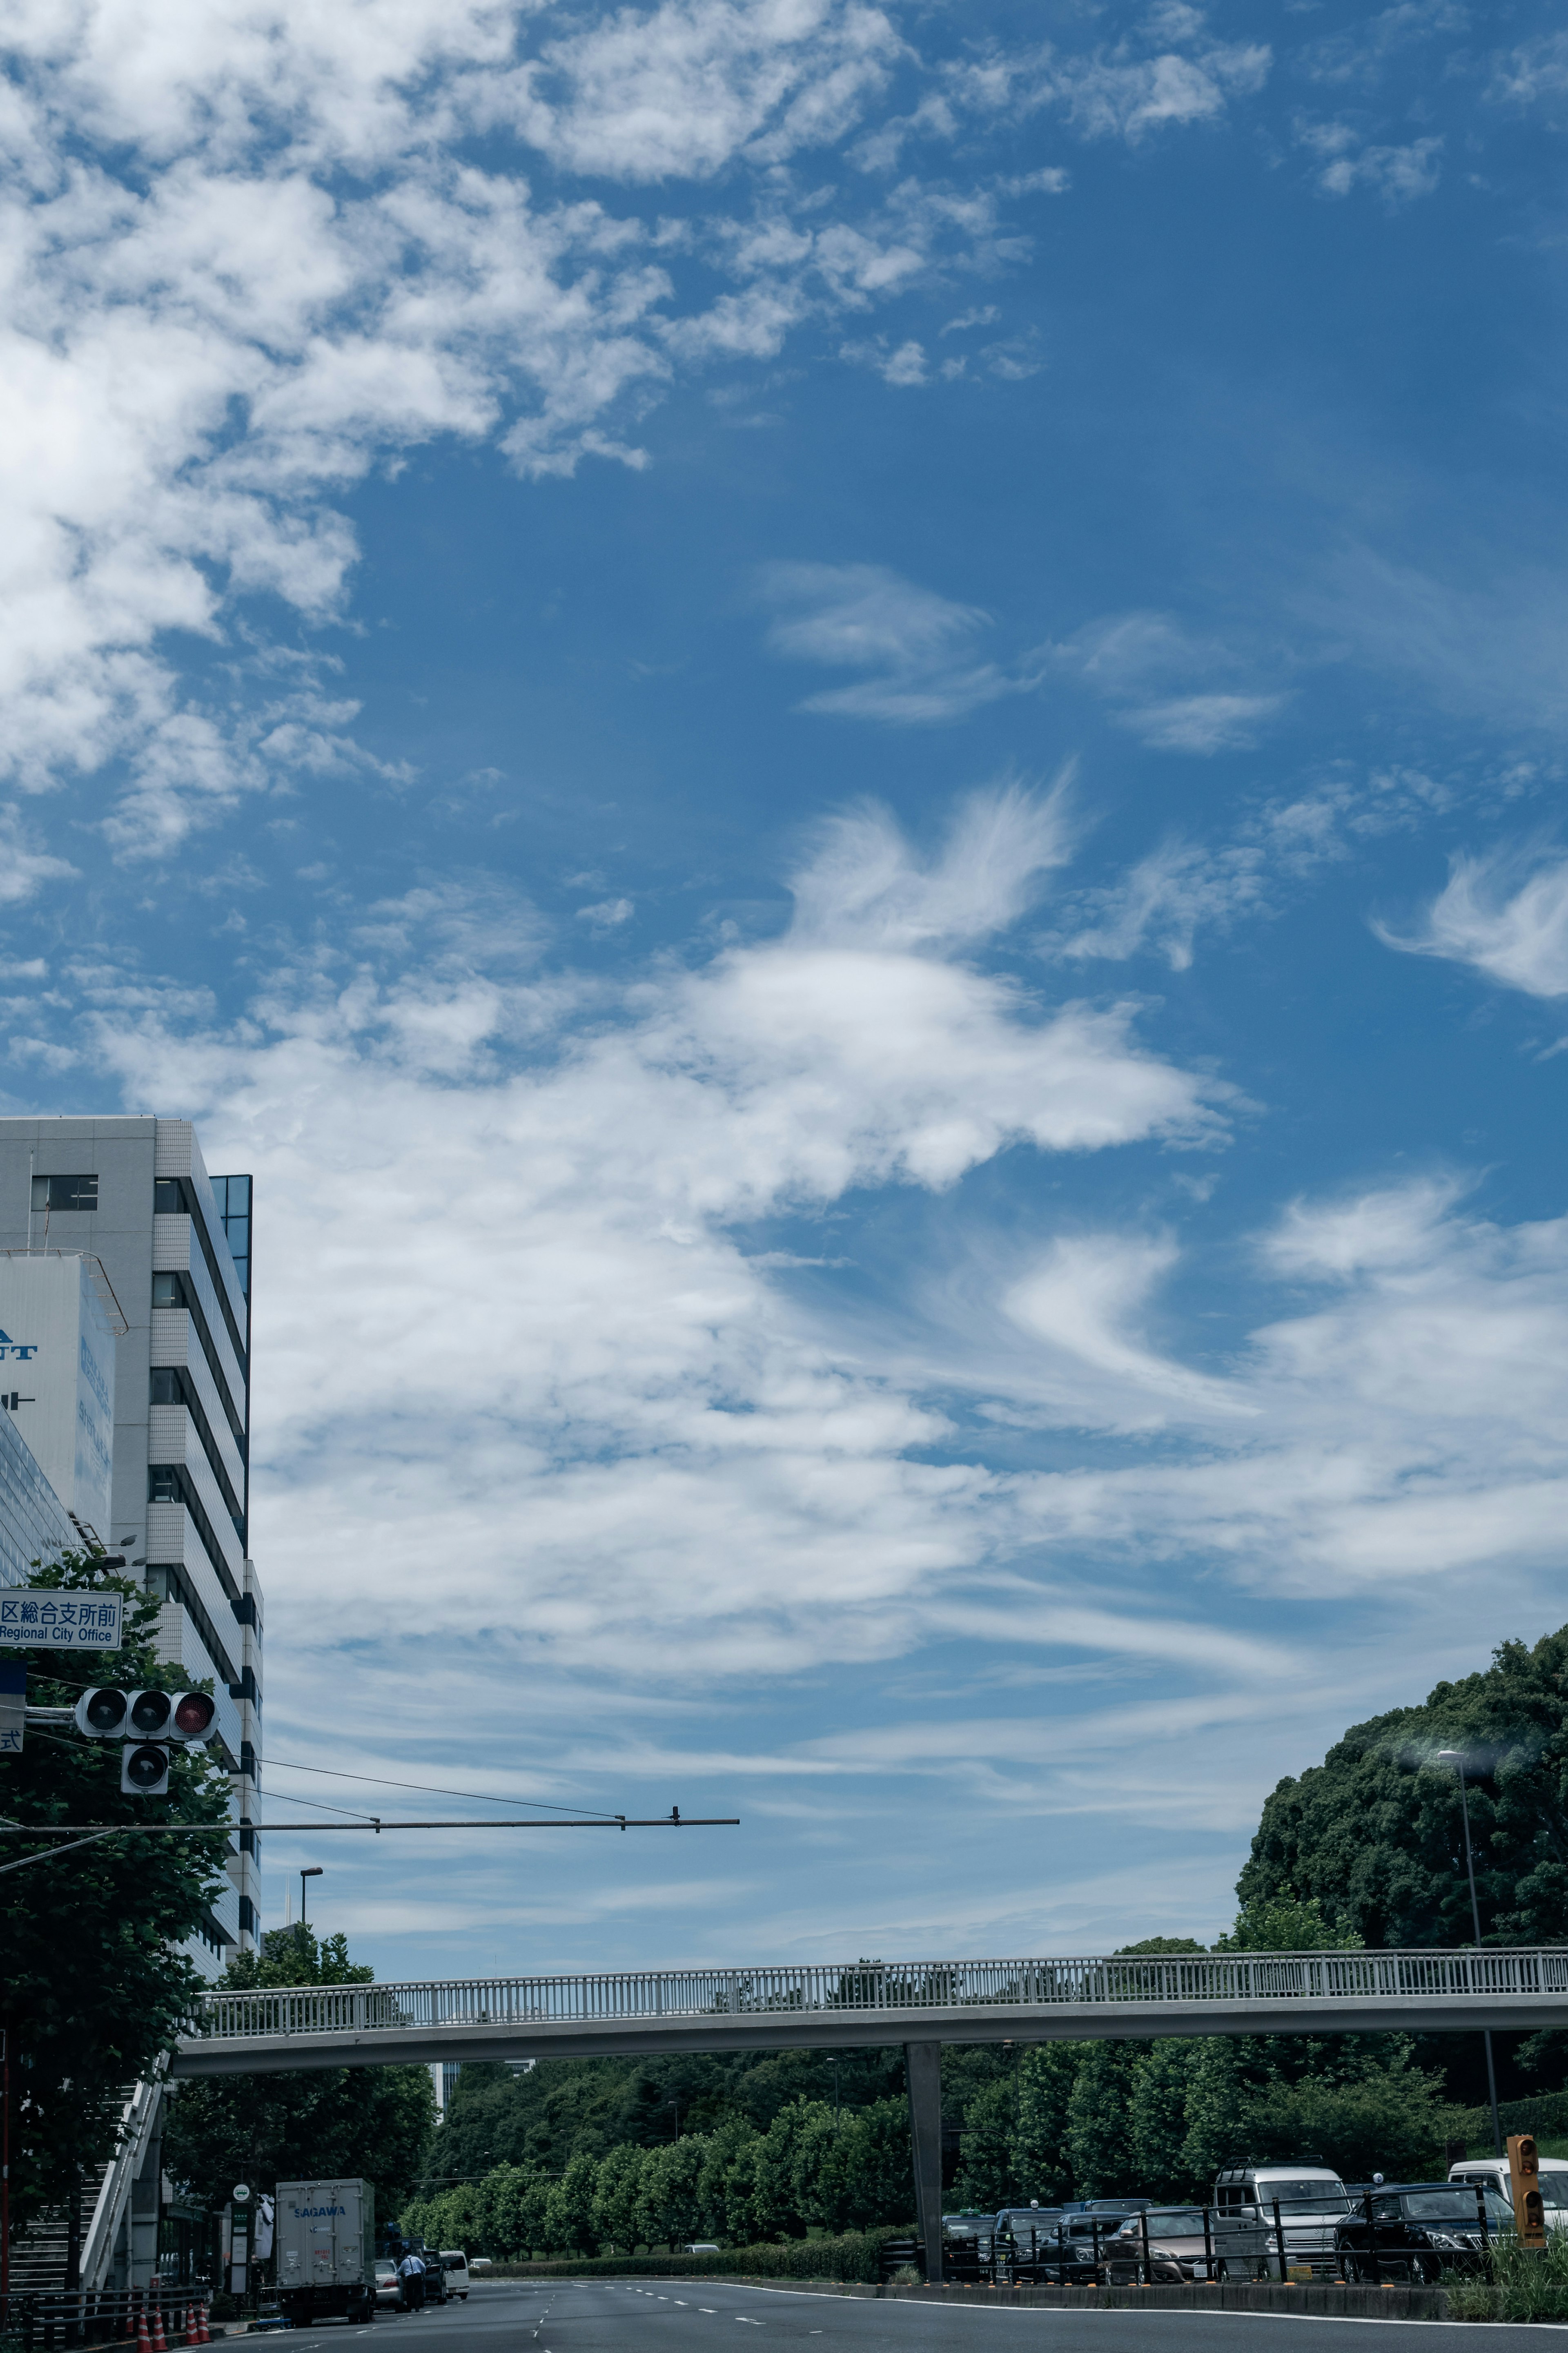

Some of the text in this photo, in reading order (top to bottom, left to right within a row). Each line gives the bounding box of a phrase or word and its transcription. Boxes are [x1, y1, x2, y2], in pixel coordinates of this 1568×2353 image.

[2, 1601, 116, 1627] 区総合支所前
[0, 1626, 112, 1643] Regional City Office
[0, 1730, 21, 1751] 式
[294, 2206, 346, 2218] SAGAWA
